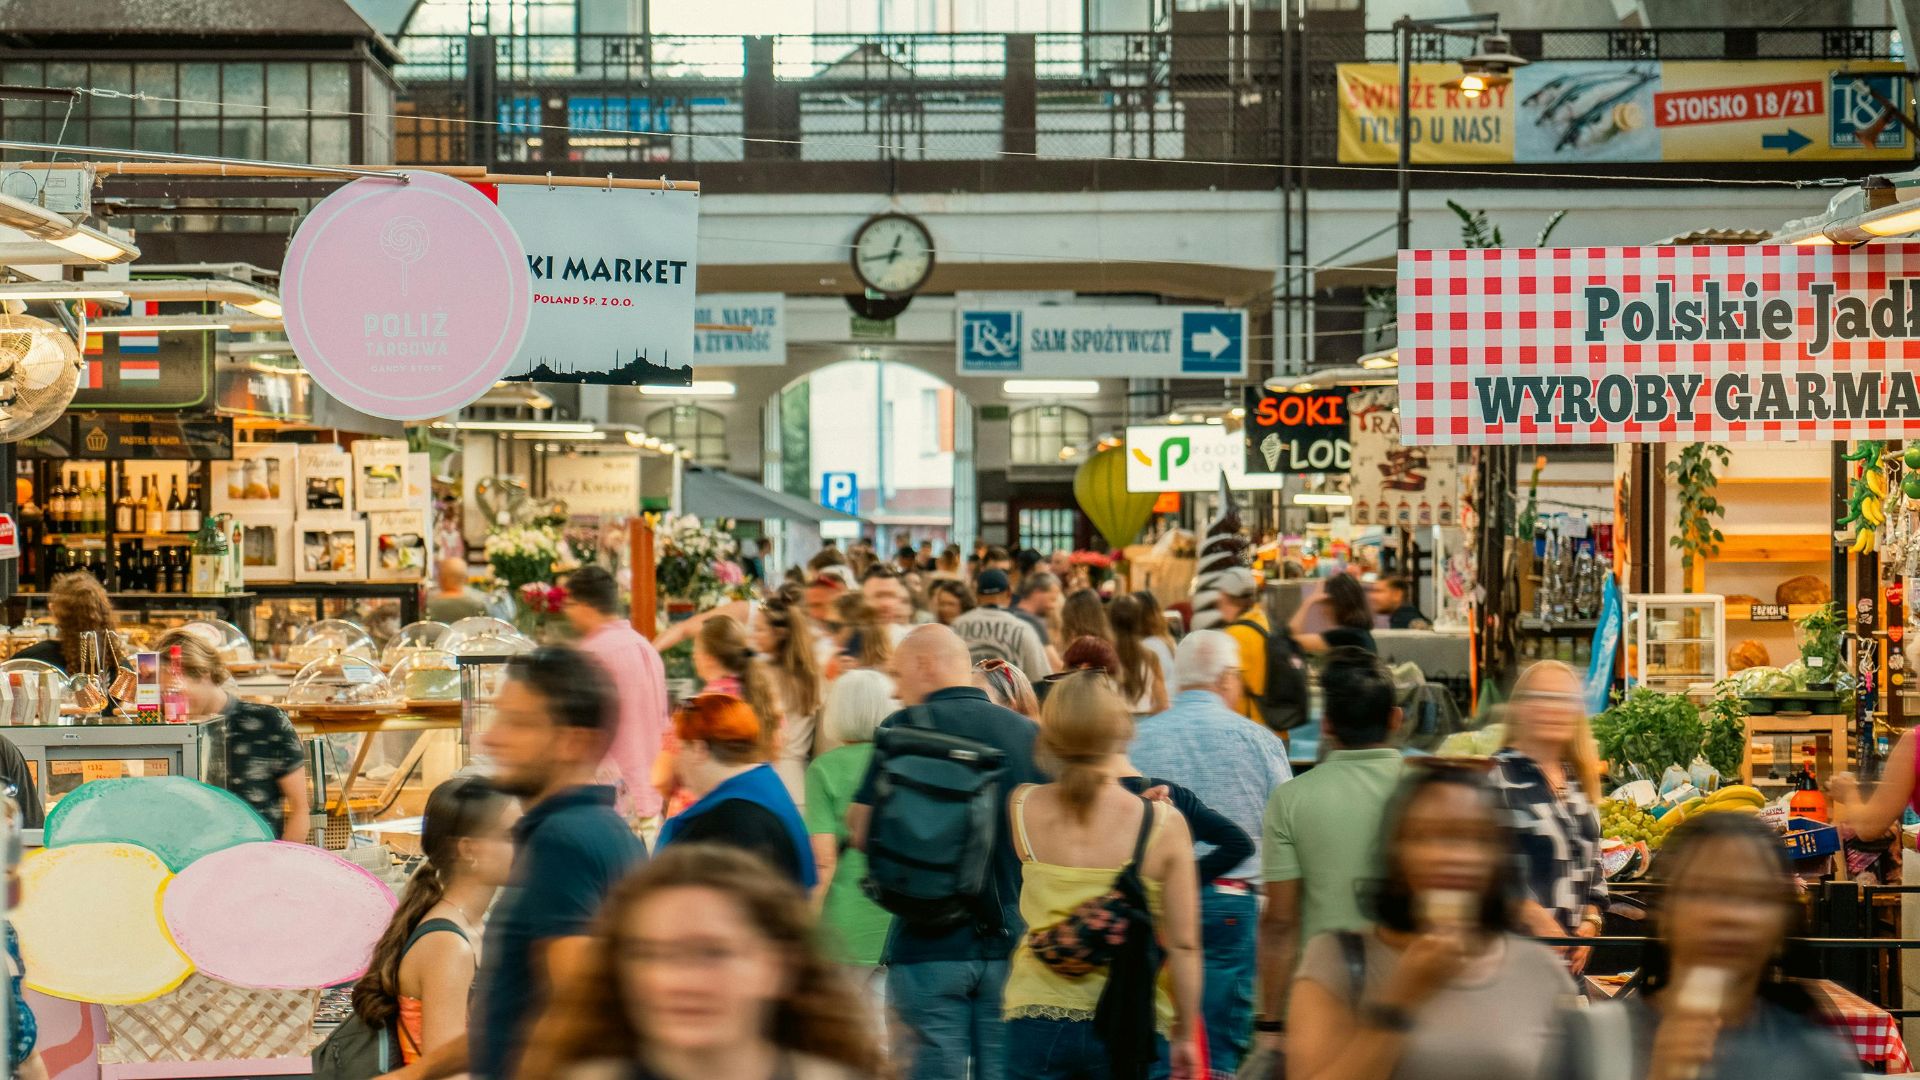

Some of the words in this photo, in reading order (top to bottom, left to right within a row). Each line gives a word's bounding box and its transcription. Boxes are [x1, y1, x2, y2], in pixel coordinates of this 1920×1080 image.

[1664, 96, 1748, 123] STOISKO
[1755, 89, 1816, 119] 18/21
[1431, 116, 1444, 143] U
[1452, 115, 1501, 143] NAS!
[562, 256, 688, 285] MARKET
[1584, 281, 1793, 342] Polskie
[1031, 328, 1066, 352] SAM
[1071, 324, 1172, 353] SPOŻYWCZY
[1256, 396, 1344, 427] SOKI
[1474, 374, 1703, 424] WYROBY
[1714, 372, 1920, 422] GARMA
